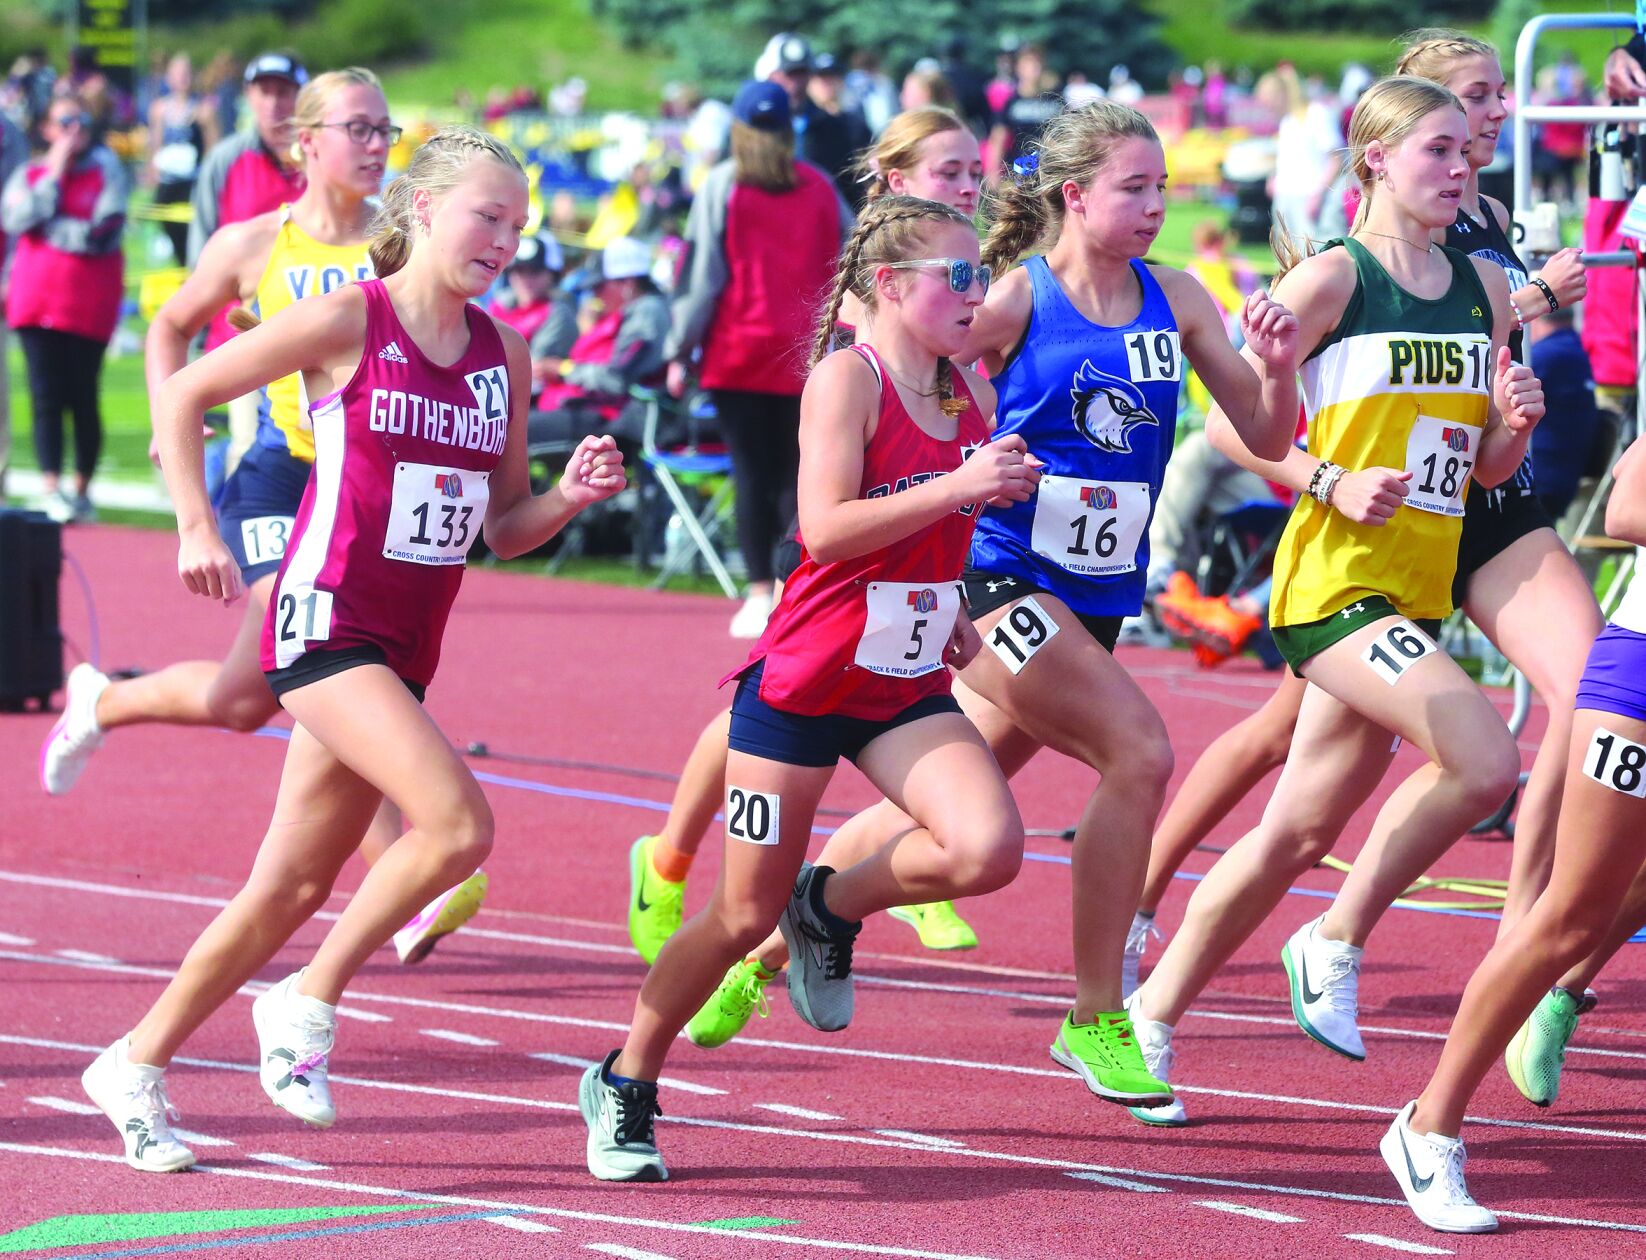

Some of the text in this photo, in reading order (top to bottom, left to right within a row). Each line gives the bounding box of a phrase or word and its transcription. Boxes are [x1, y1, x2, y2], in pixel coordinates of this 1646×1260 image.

[378, 351, 409, 364] adidas
[1129, 332, 1175, 379] 19
[1388, 338, 1465, 386] PIUS
[472, 369, 507, 420] 21
[369, 388, 507, 456] GOTHENBUR
[1418, 452, 1473, 499] 187
[408, 501, 474, 548] 133
[1406, 497, 1422, 508] CROSS
[1422, 501, 1446, 512] COUNTRY
[247, 520, 288, 558] 13
[392, 550, 414, 560] CROSS
[1066, 514, 1118, 558] 16
[1068, 563, 1086, 572] FIELD
[1086, 563, 1127, 573] CHAMPIONSHIPS
[279, 593, 317, 641] 21
[903, 619, 928, 660] 5
[992, 605, 1048, 664] 19
[891, 667, 908, 676] FIELD
[1369, 626, 1426, 675] 16
[1593, 734, 1646, 792] 18
[729, 788, 770, 841] 20
